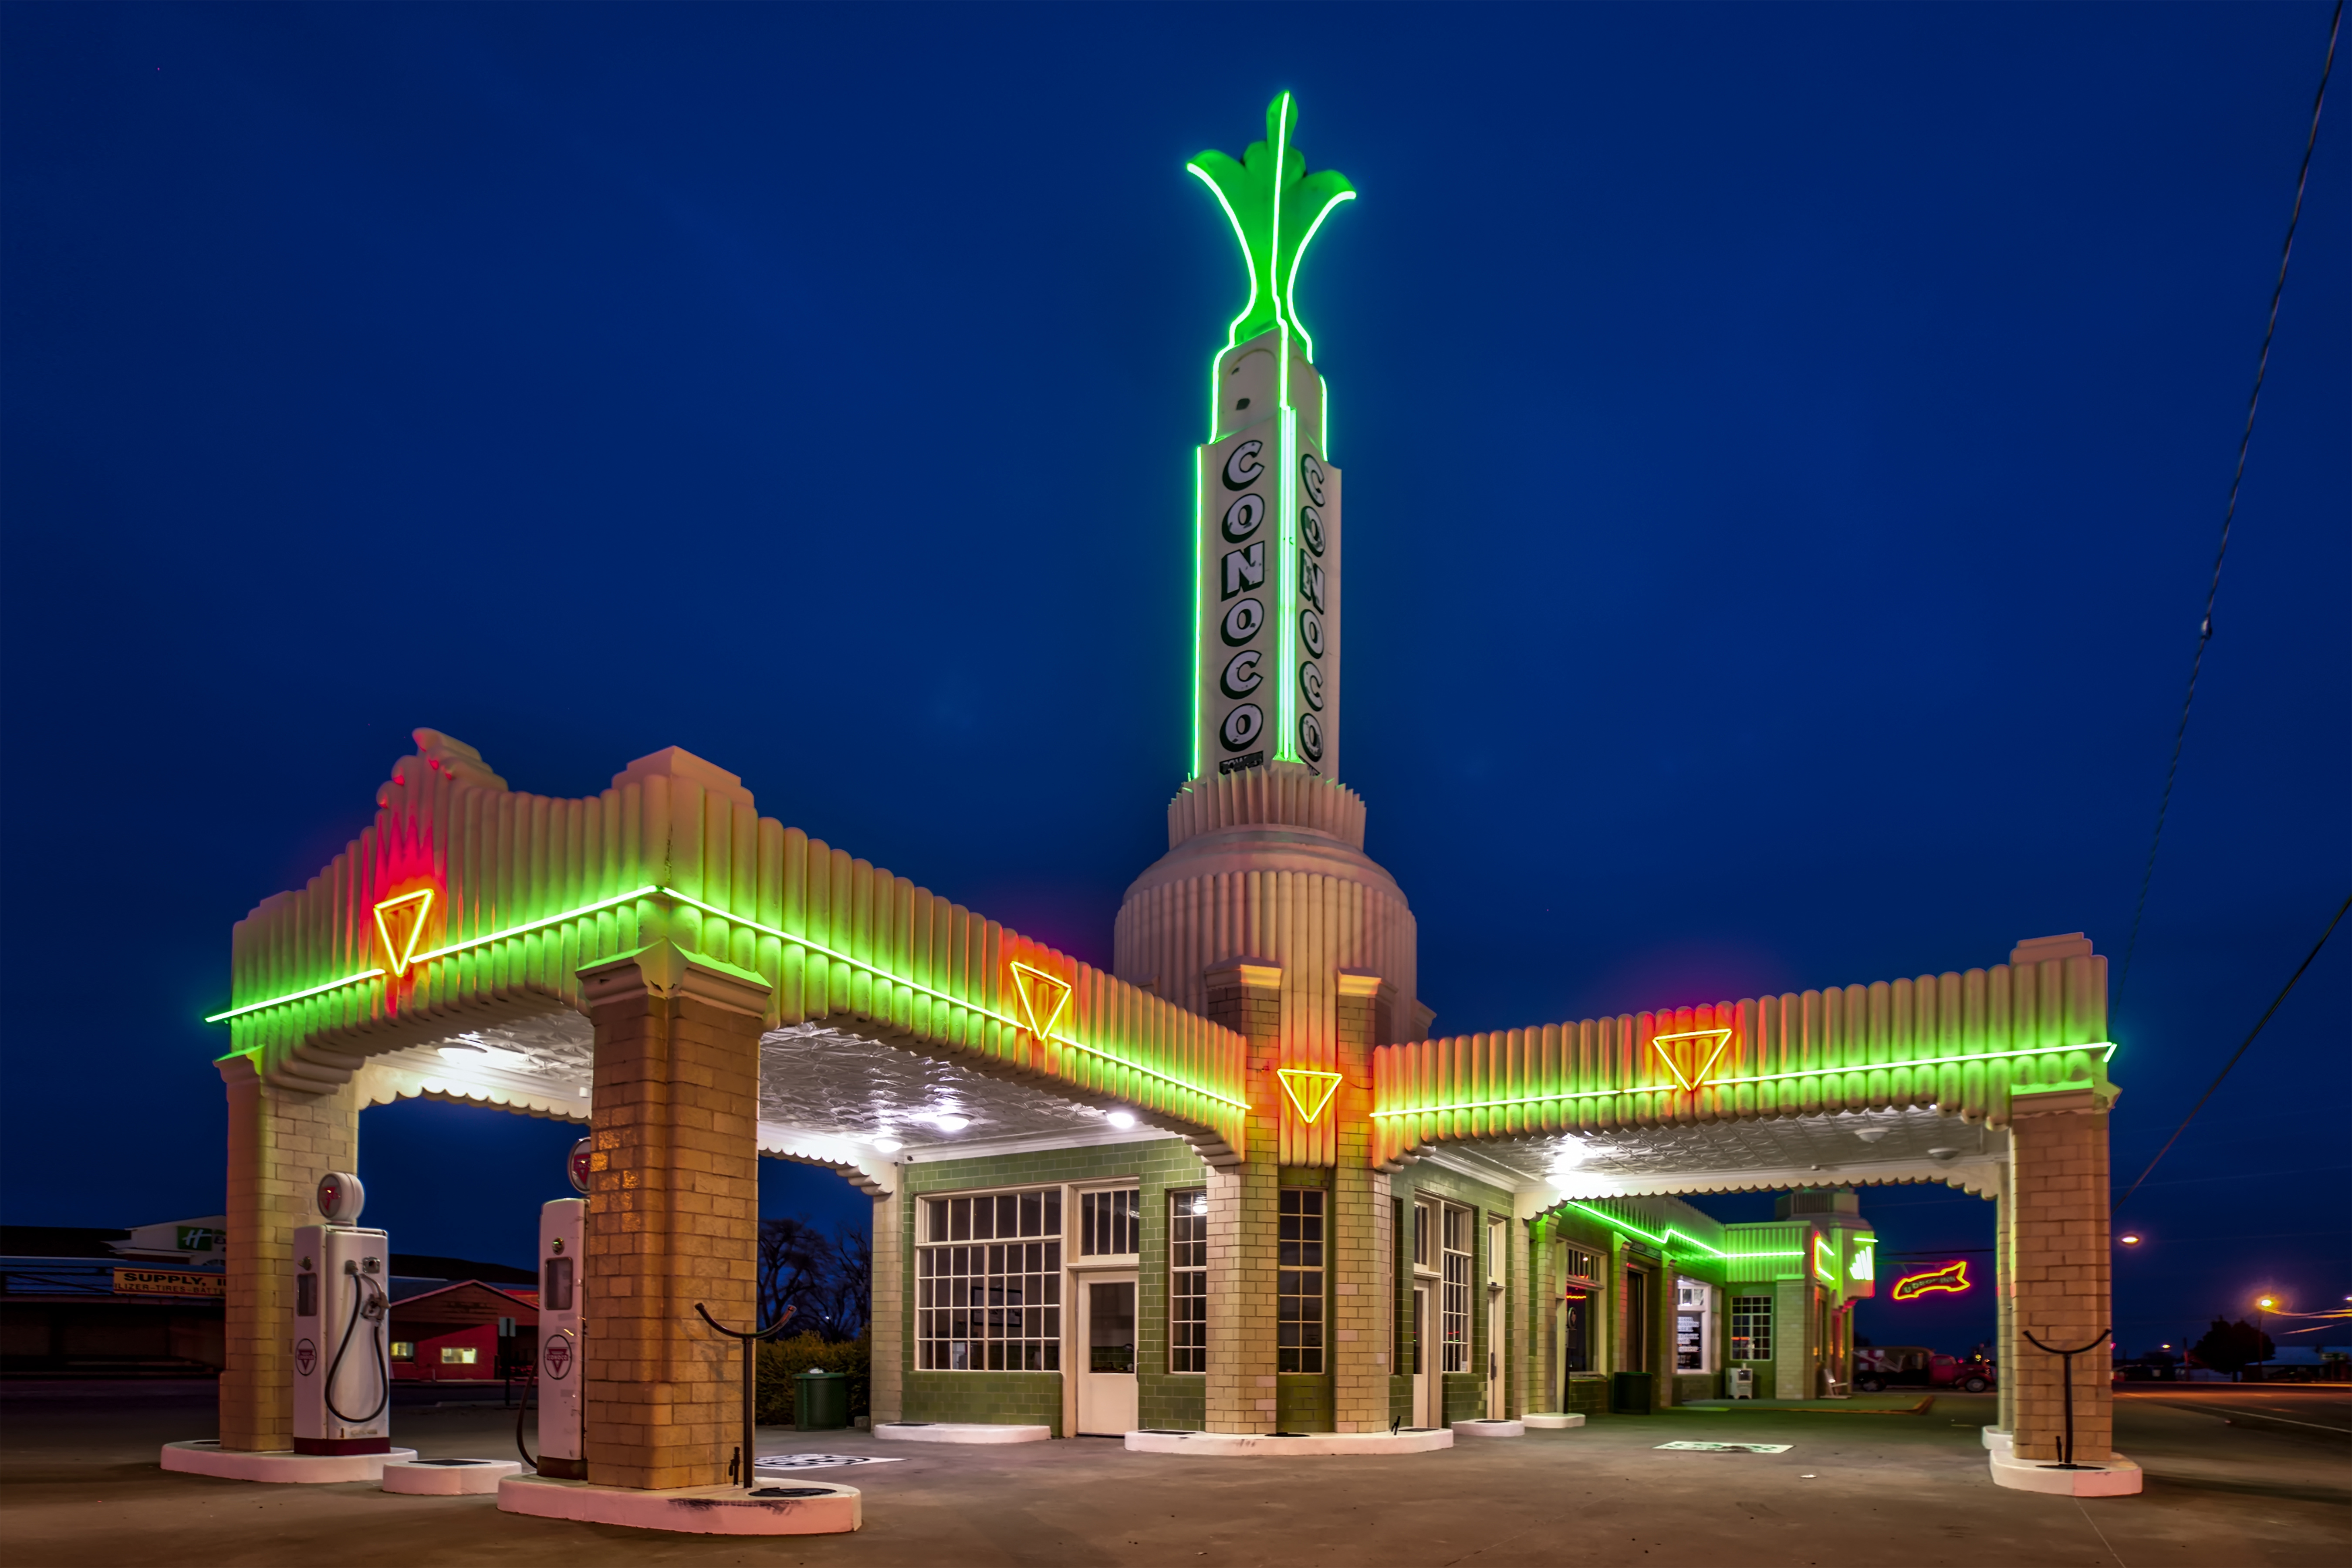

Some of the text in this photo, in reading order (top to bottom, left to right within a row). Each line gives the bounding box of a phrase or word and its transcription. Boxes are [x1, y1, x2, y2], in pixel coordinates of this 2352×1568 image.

[1220, 440, 1265, 752] CONOCO
[1299, 454, 1325, 762] CONOCO
[123, 1273, 206, 1286] SUPPLY,
